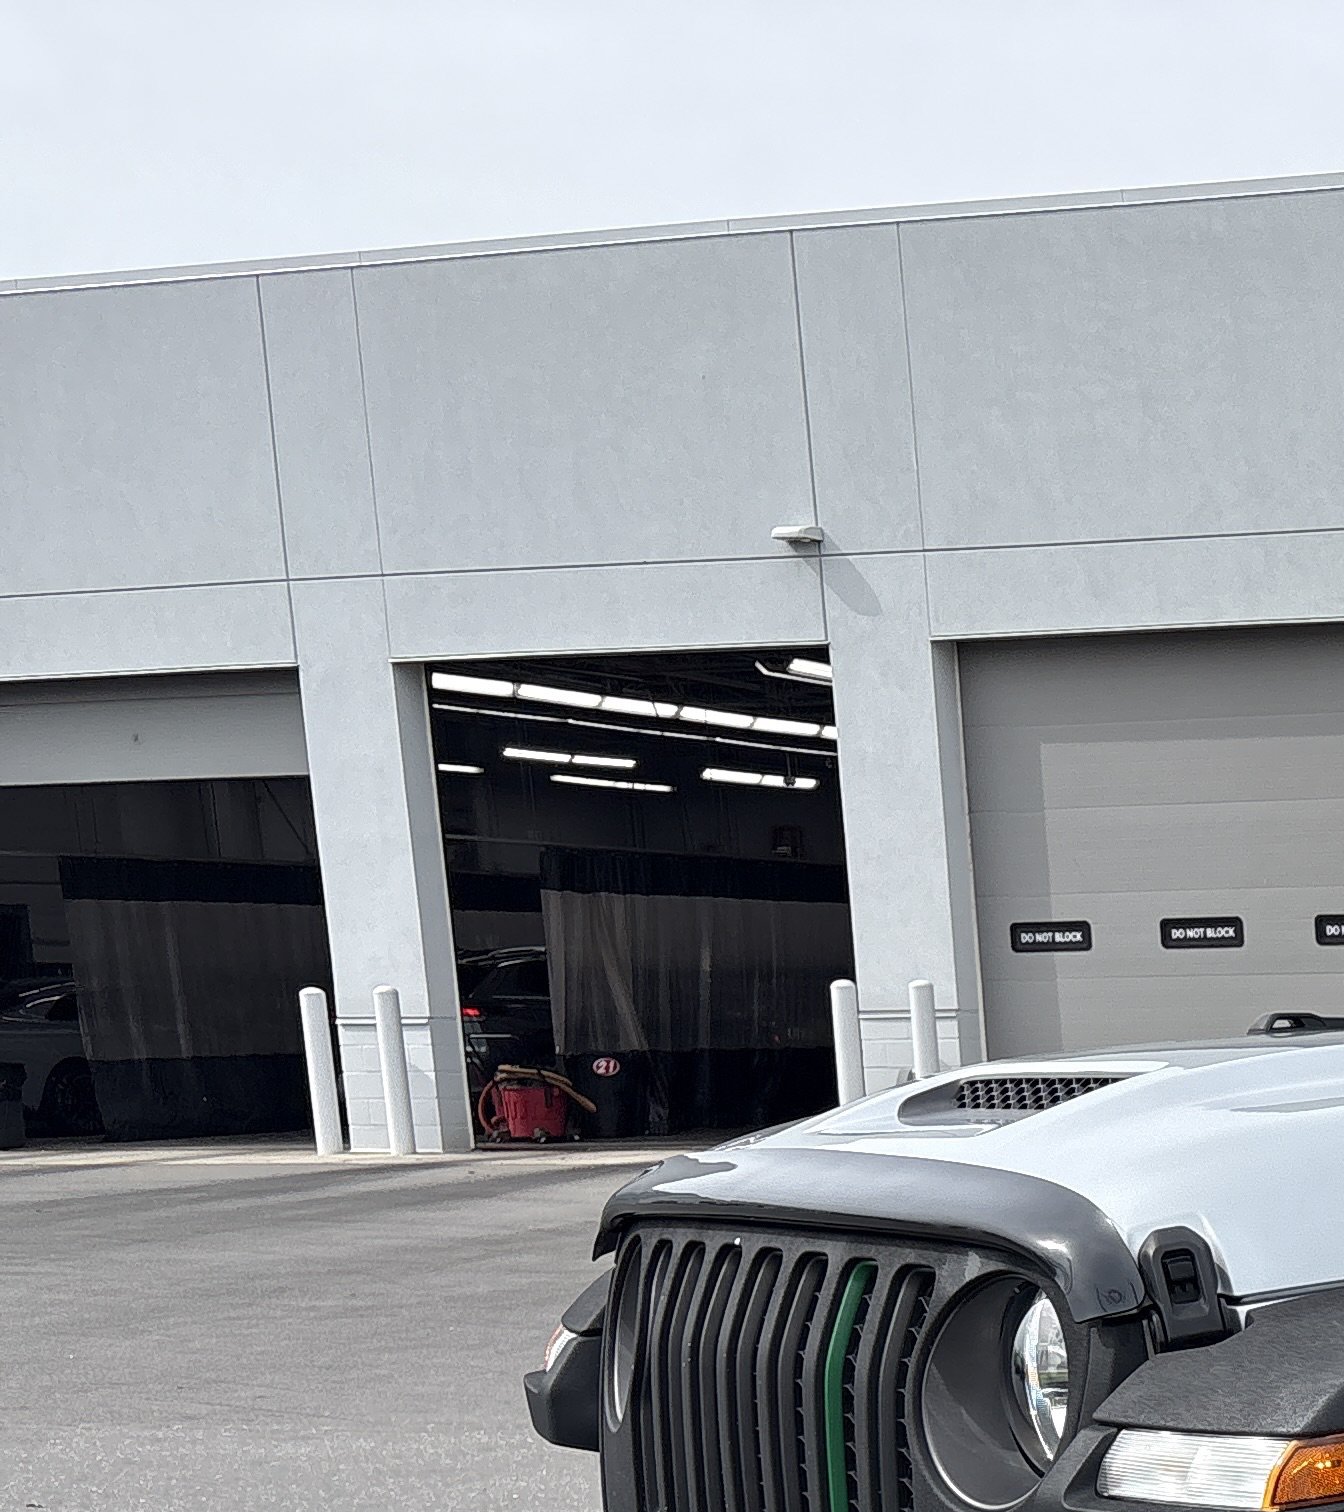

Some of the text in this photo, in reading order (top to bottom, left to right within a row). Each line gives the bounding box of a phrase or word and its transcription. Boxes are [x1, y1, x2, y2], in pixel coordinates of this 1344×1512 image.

[1171, 926, 1235, 939] DO NOT BLOCK
[1325, 924, 1340, 936] DO
[1020, 931, 1083, 943] DO NOT BLOCK
[596, 1060, 615, 1074] 21
